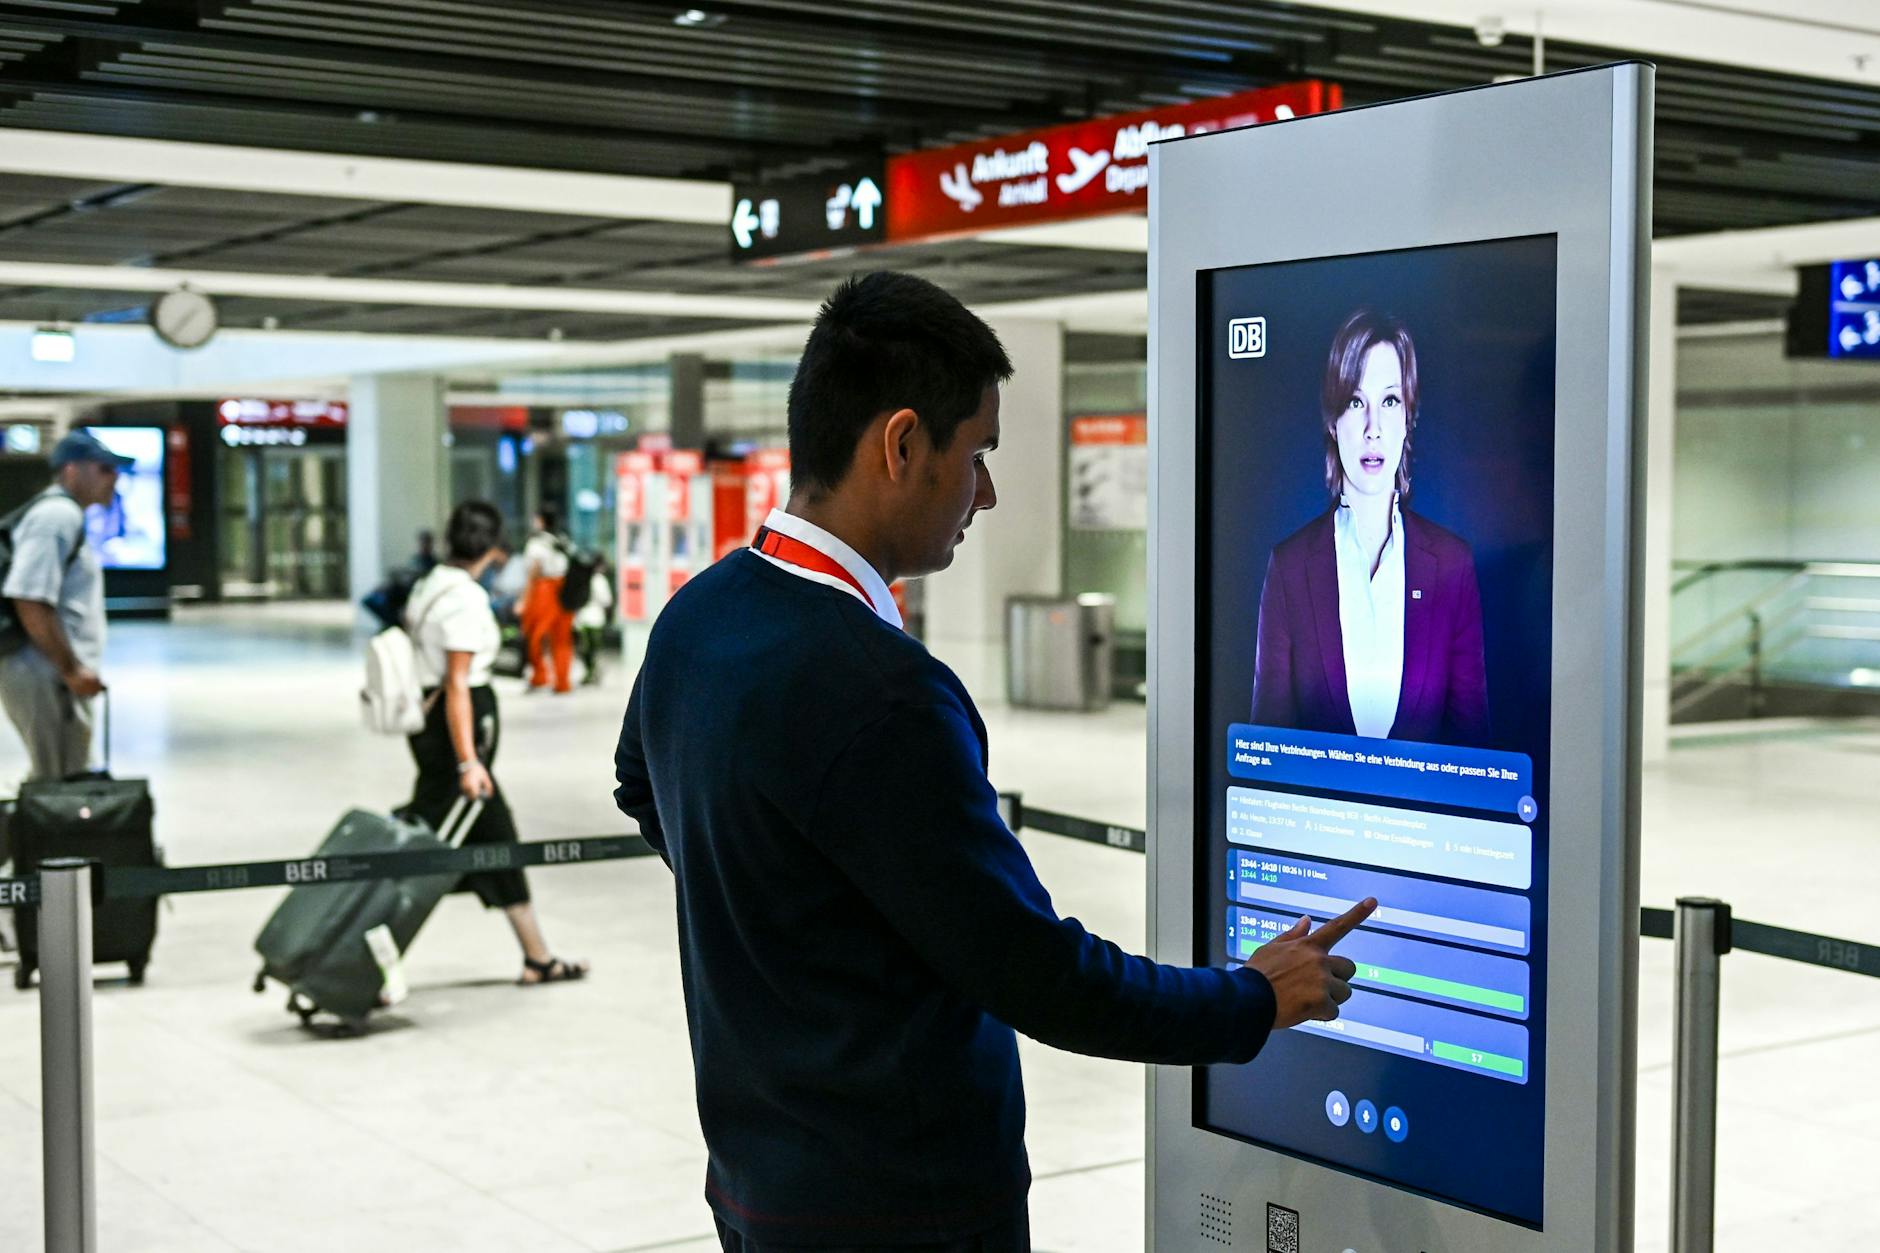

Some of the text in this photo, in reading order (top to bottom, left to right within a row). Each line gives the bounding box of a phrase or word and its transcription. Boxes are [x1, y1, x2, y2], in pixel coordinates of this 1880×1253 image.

[971, 141, 1049, 183] Ankunft
[1233, 323, 1262, 353] DB
[1235, 753, 1272, 766] Anfrage an.
[1235, 739, 1518, 781] Hier sind Ihre Verbindungen. Wählen Sie eine Verbindung aus oder passen Sie Ihre
[543, 841, 582, 862] BER
[285, 860, 327, 882] BER
[1241, 858, 1256, 869] 13:44
[1241, 869, 1256, 879] 13:44
[1229, 870, 1234, 880] 1
[0, 881, 27, 904] ER
[1229, 927, 1234, 937] 2
